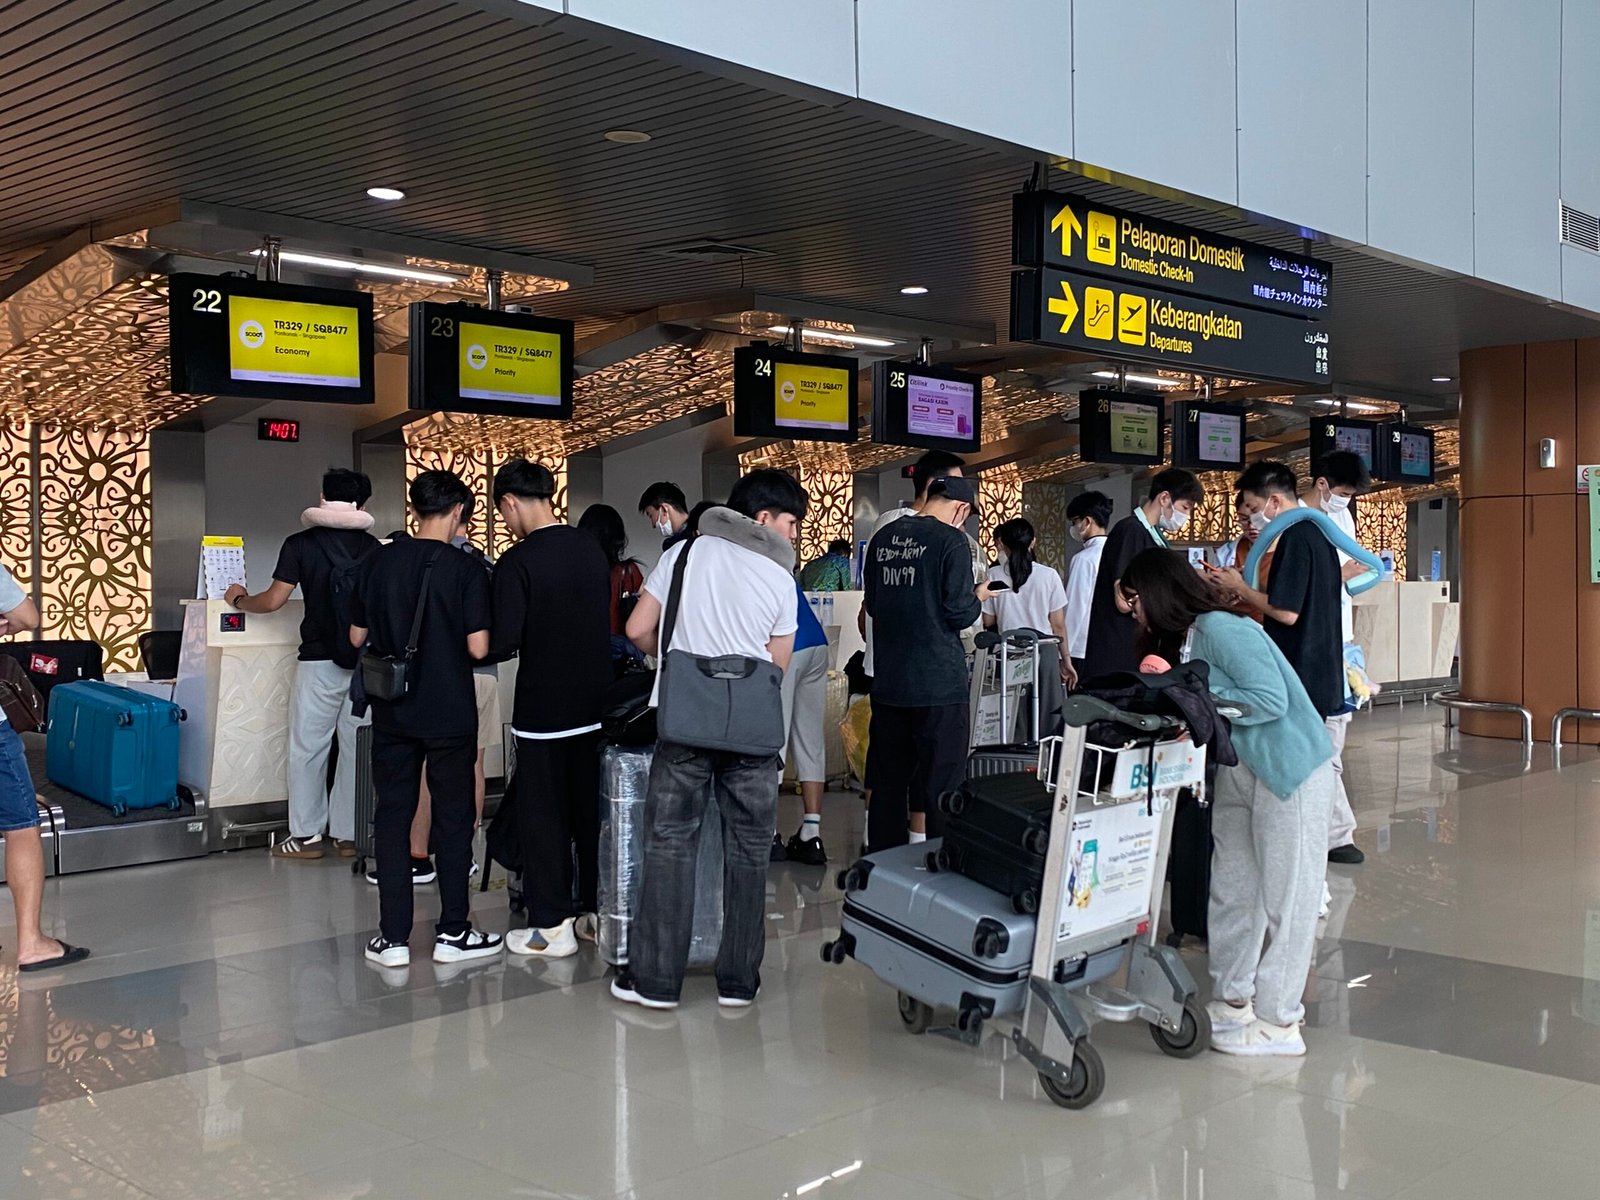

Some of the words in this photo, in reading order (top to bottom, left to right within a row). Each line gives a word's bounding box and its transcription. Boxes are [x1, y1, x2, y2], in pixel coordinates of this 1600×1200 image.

[1121, 218, 1186, 259] Pelaporan
[1189, 235, 1245, 272] Domestik
[1121, 252, 1159, 276] Domestic
[1159, 261, 1194, 283] Check-In
[192, 288, 222, 314] 22
[1150, 298, 1242, 341] Keberangkatan
[273, 320, 303, 331] TR329
[306, 323, 311, 333] /
[313, 324, 348, 335] SQ8477
[431, 317, 455, 338] 23
[1150, 331, 1193, 354] Departures
[275, 346, 310, 358] Economy
[494, 345, 517, 354] TR329
[519, 347, 523, 356] /
[525, 348, 552, 359] SQ8477
[494, 368, 516, 377] Priority
[755, 358, 771, 377] 24
[800, 380, 817, 389] TR329
[890, 371, 905, 388] 25
[800, 400, 816, 408] Priority
[1098, 399, 1109, 413] 26
[1188, 409, 1199, 422] 27
[1325, 424, 1335, 437] 28
[1392, 431, 1401, 443] 29
